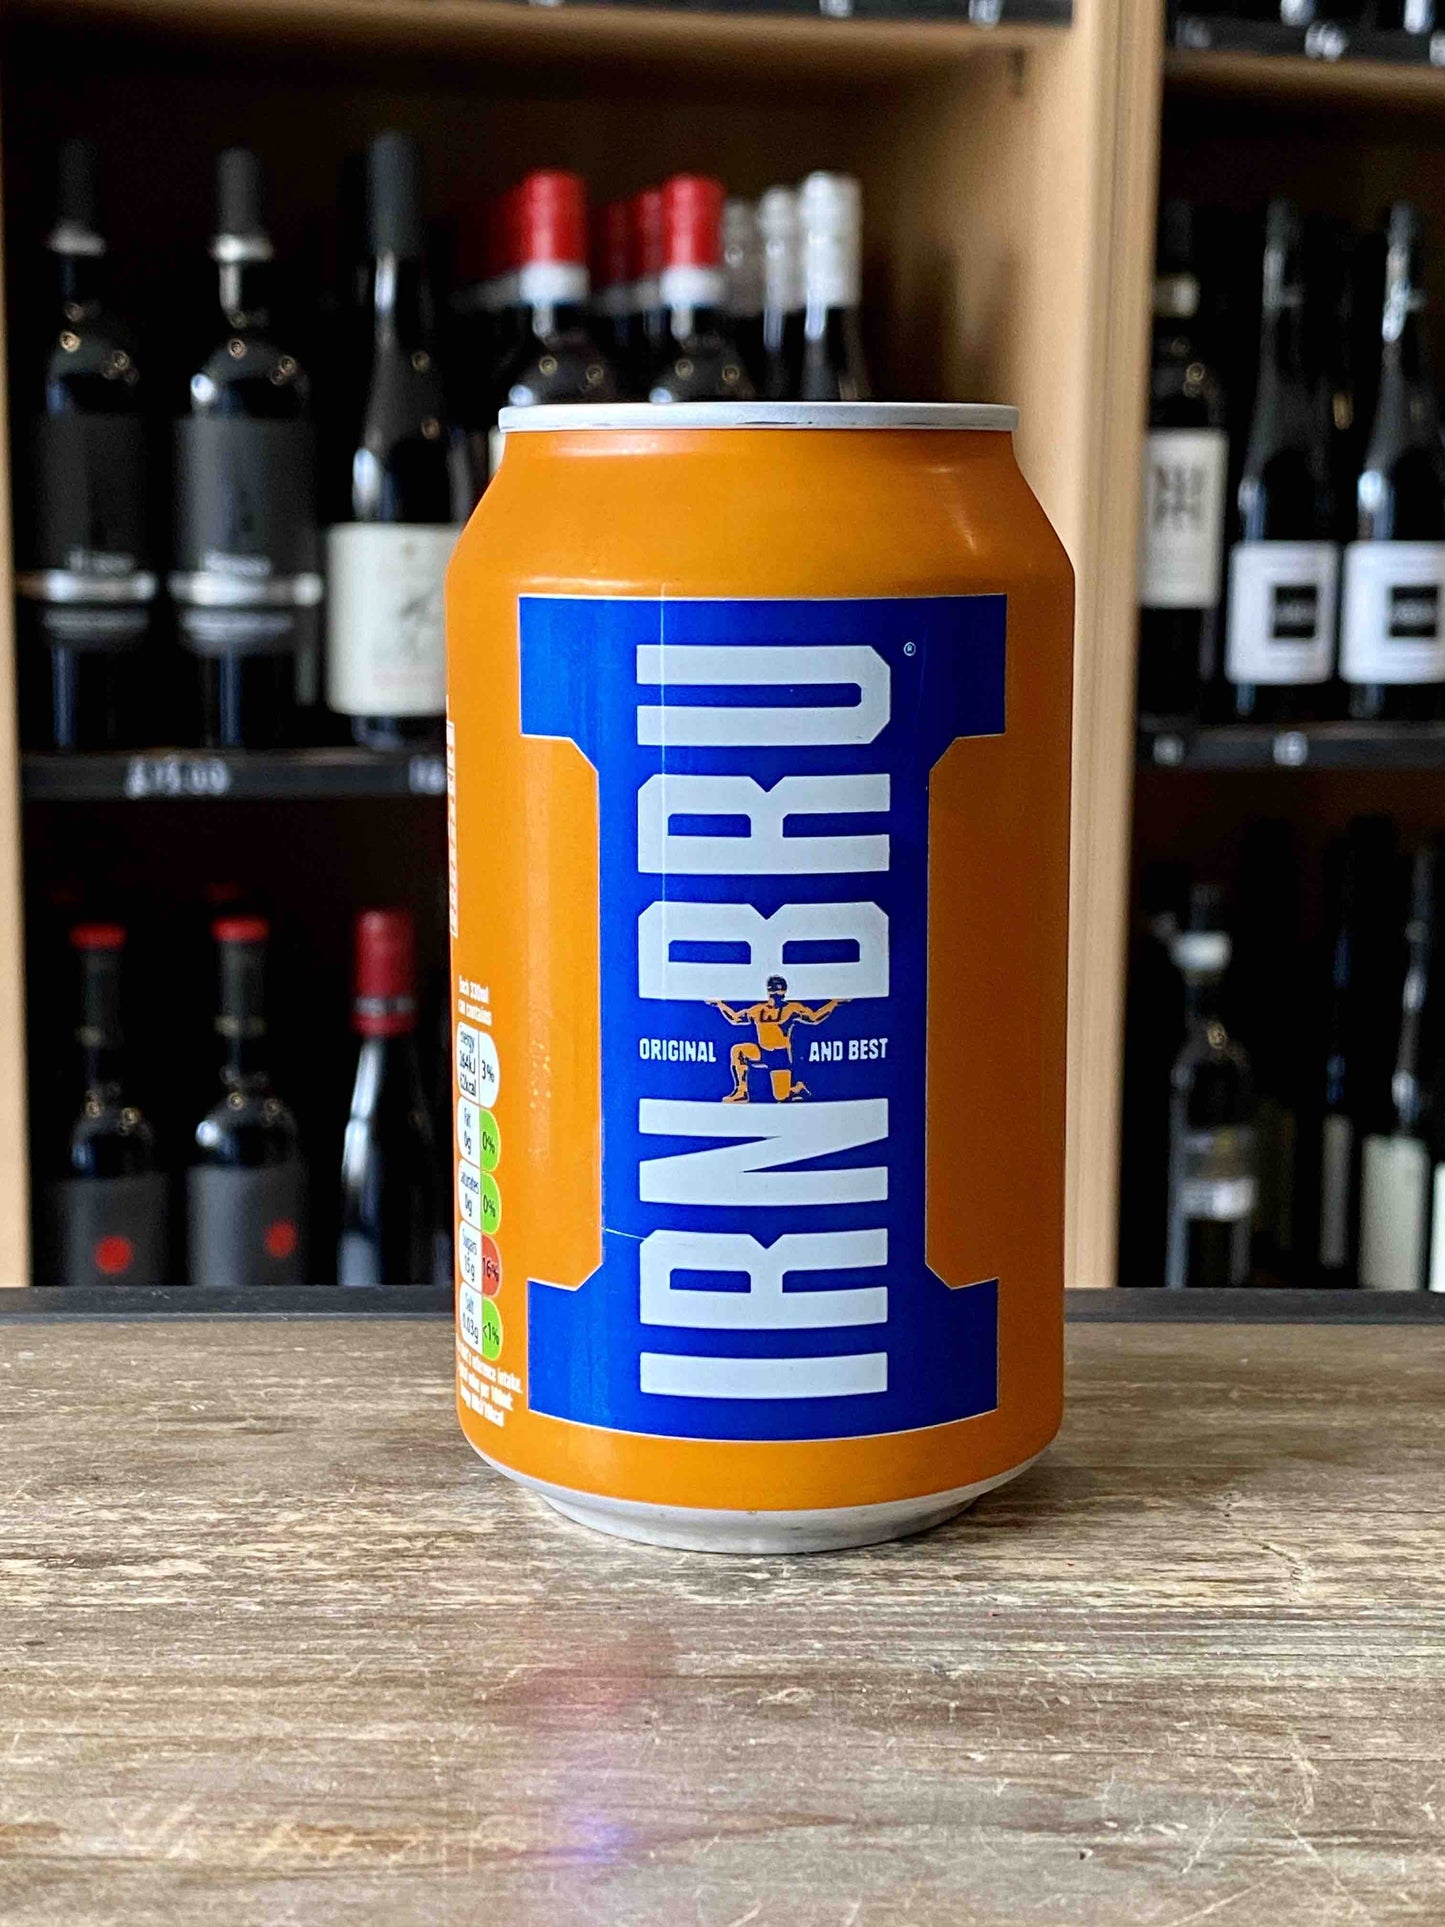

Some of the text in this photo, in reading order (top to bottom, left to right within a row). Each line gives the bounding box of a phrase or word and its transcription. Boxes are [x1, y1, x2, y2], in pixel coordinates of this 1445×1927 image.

[636, 643, 892, 1401] IRN BRU
[638, 1038, 889, 1063] ORIGINAL AND BEST
[481, 1059, 495, 1083] 3%
[482, 1131, 496, 1155] 0%
[482, 1194, 497, 1218] 0%
[482, 1256, 500, 1282] 16%
[482, 1321, 500, 1346] <1%
